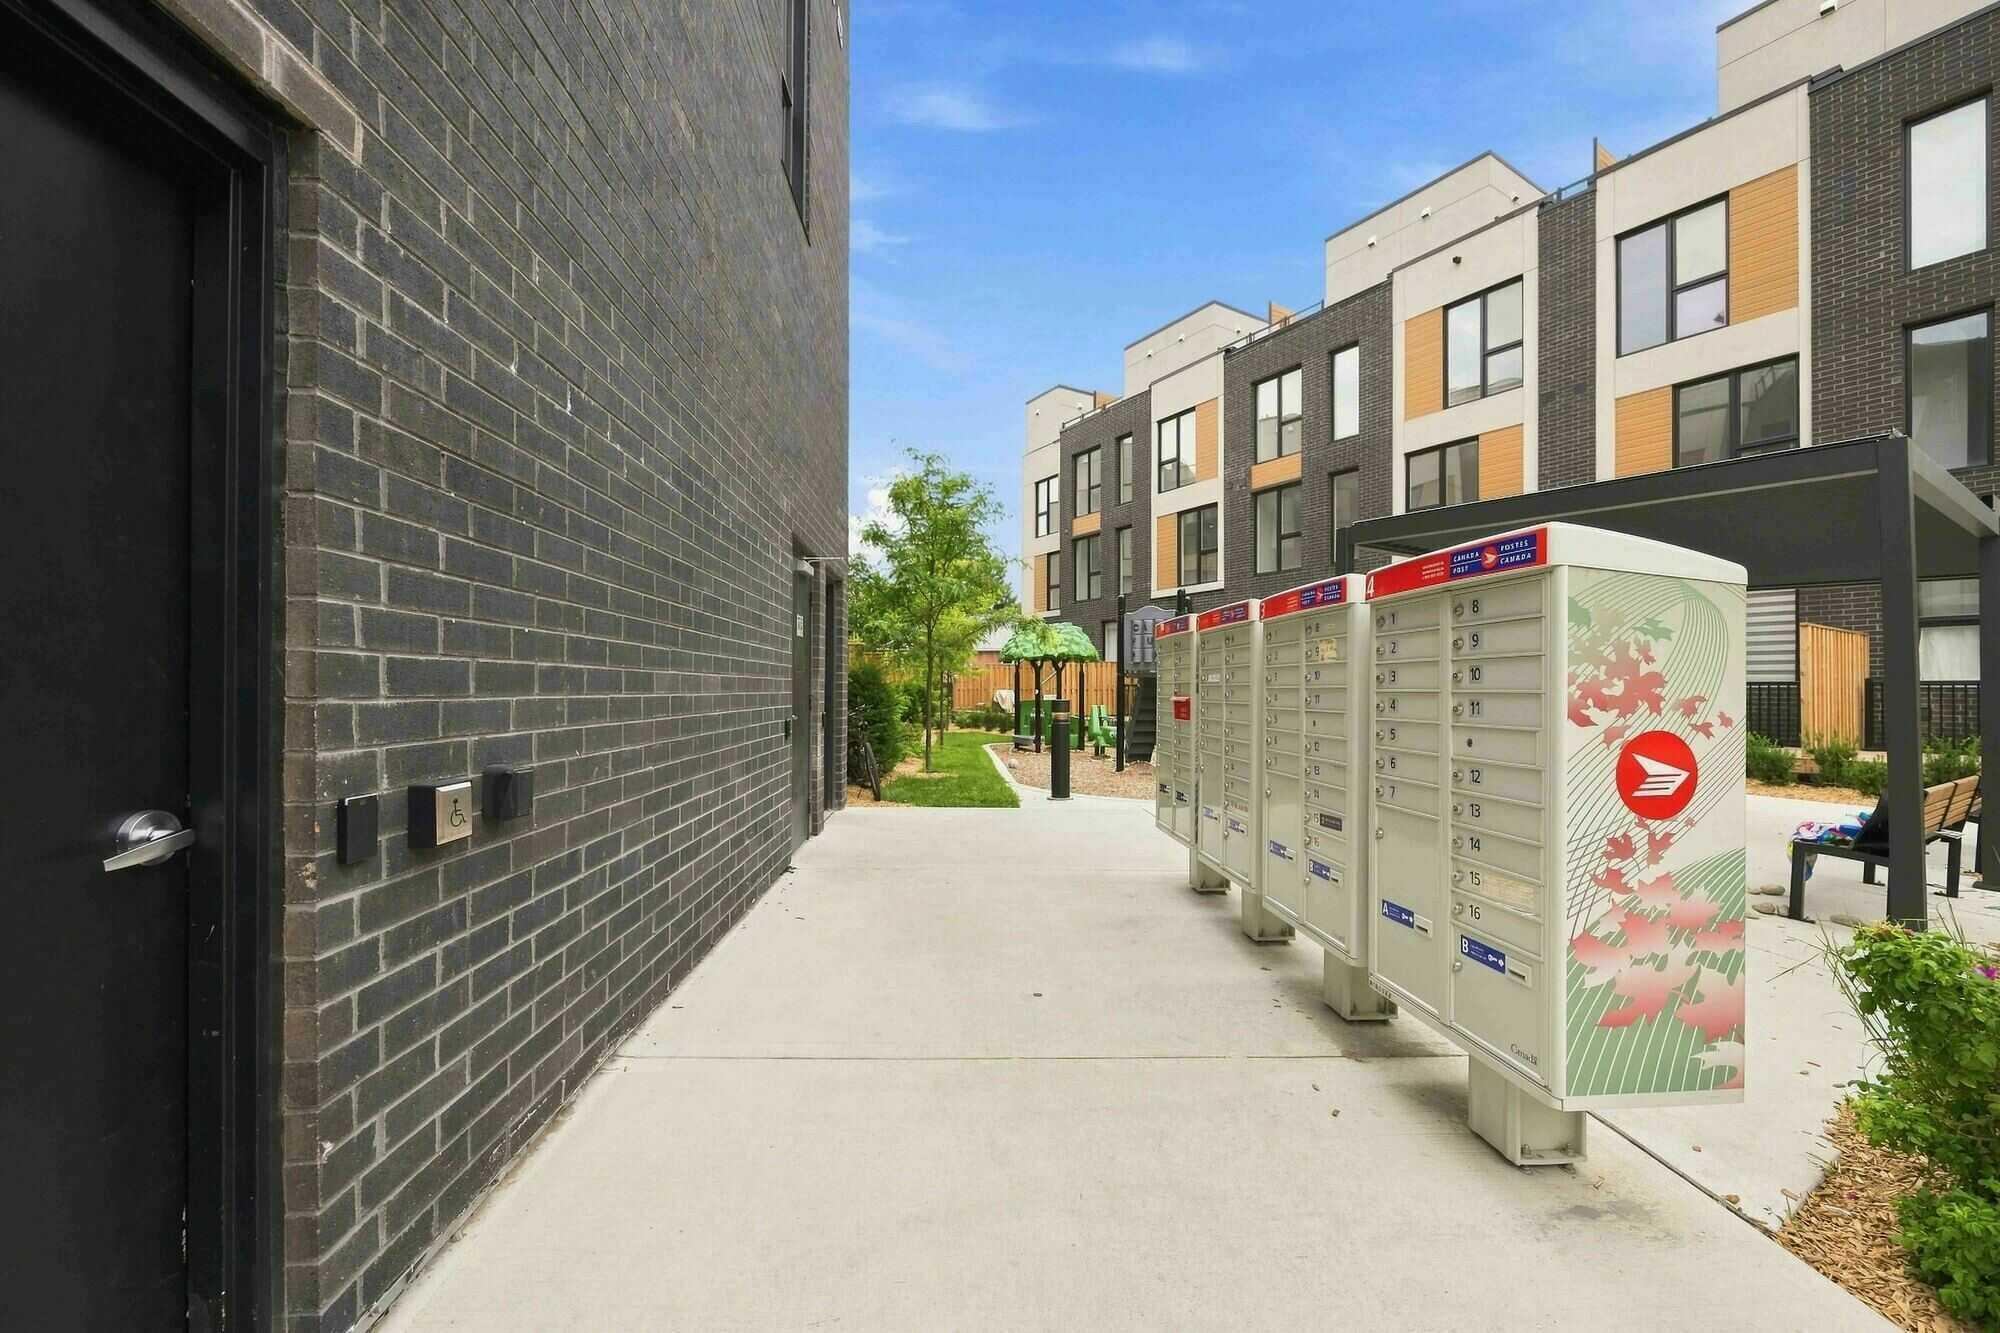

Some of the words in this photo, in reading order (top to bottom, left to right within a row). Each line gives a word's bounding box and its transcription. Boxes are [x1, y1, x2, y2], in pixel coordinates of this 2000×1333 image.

[1501, 540, 1529, 551] POSTES
[1453, 551, 1480, 562] CANADA
[1500, 552, 1532, 565] CANADA
[1453, 566, 1468, 575] POST
[1367, 576, 1375, 597] 4
[1472, 600, 1479, 613] 8
[1391, 614, 1395, 625] 1
[1472, 634, 1479, 647] 9
[1391, 642, 1396, 654] 2
[1391, 671, 1396, 682] 3
[1470, 667, 1481, 681] 10
[1390, 699, 1396, 711] 4
[1470, 702, 1480, 715] 11
[1390, 729, 1396, 740] 5
[1390, 758, 1396, 769] 6
[1470, 770, 1481, 783] 12
[1390, 786, 1396, 798] 7
[1470, 804, 1481, 818] 13
[1469, 837, 1481, 851] 14
[1469, 872, 1481, 886] 15
[1383, 902, 1389, 915] A
[1469, 905, 1481, 919] 16
[1462, 938, 1469, 953] B
